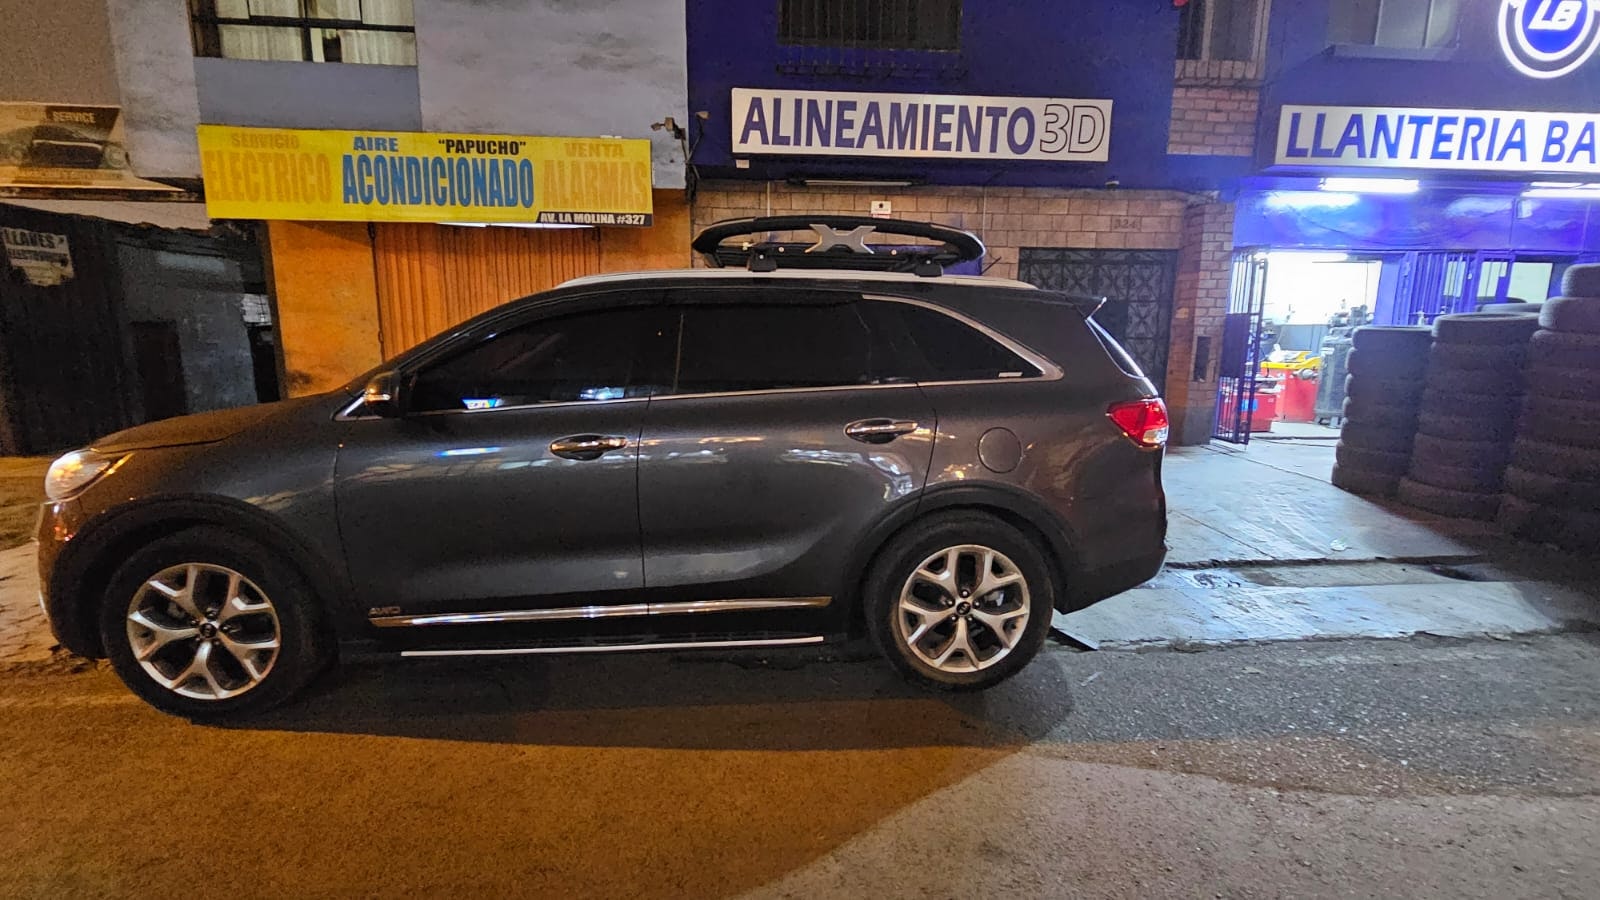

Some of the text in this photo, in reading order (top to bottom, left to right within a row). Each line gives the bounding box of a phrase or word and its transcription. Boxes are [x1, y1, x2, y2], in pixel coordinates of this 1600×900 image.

[52, 111, 96, 123] SERVICE
[739, 97, 1105, 155] ALINEAMIENTO 3D
[231, 133, 300, 149] SERVICIO
[353, 137, 399, 152] AIRE
[1285, 112, 1597, 163] LLANTERIA BA
[438, 139, 526, 155] "PAPUCHO"
[565, 143, 624, 158] VENTA
[203, 151, 331, 205] ELECTRICO
[342, 154, 535, 208] ACONDICIONADO
[542, 160, 648, 212] ALARMAS
[540, 213, 645, 225] AV. LA MOLINA #327
